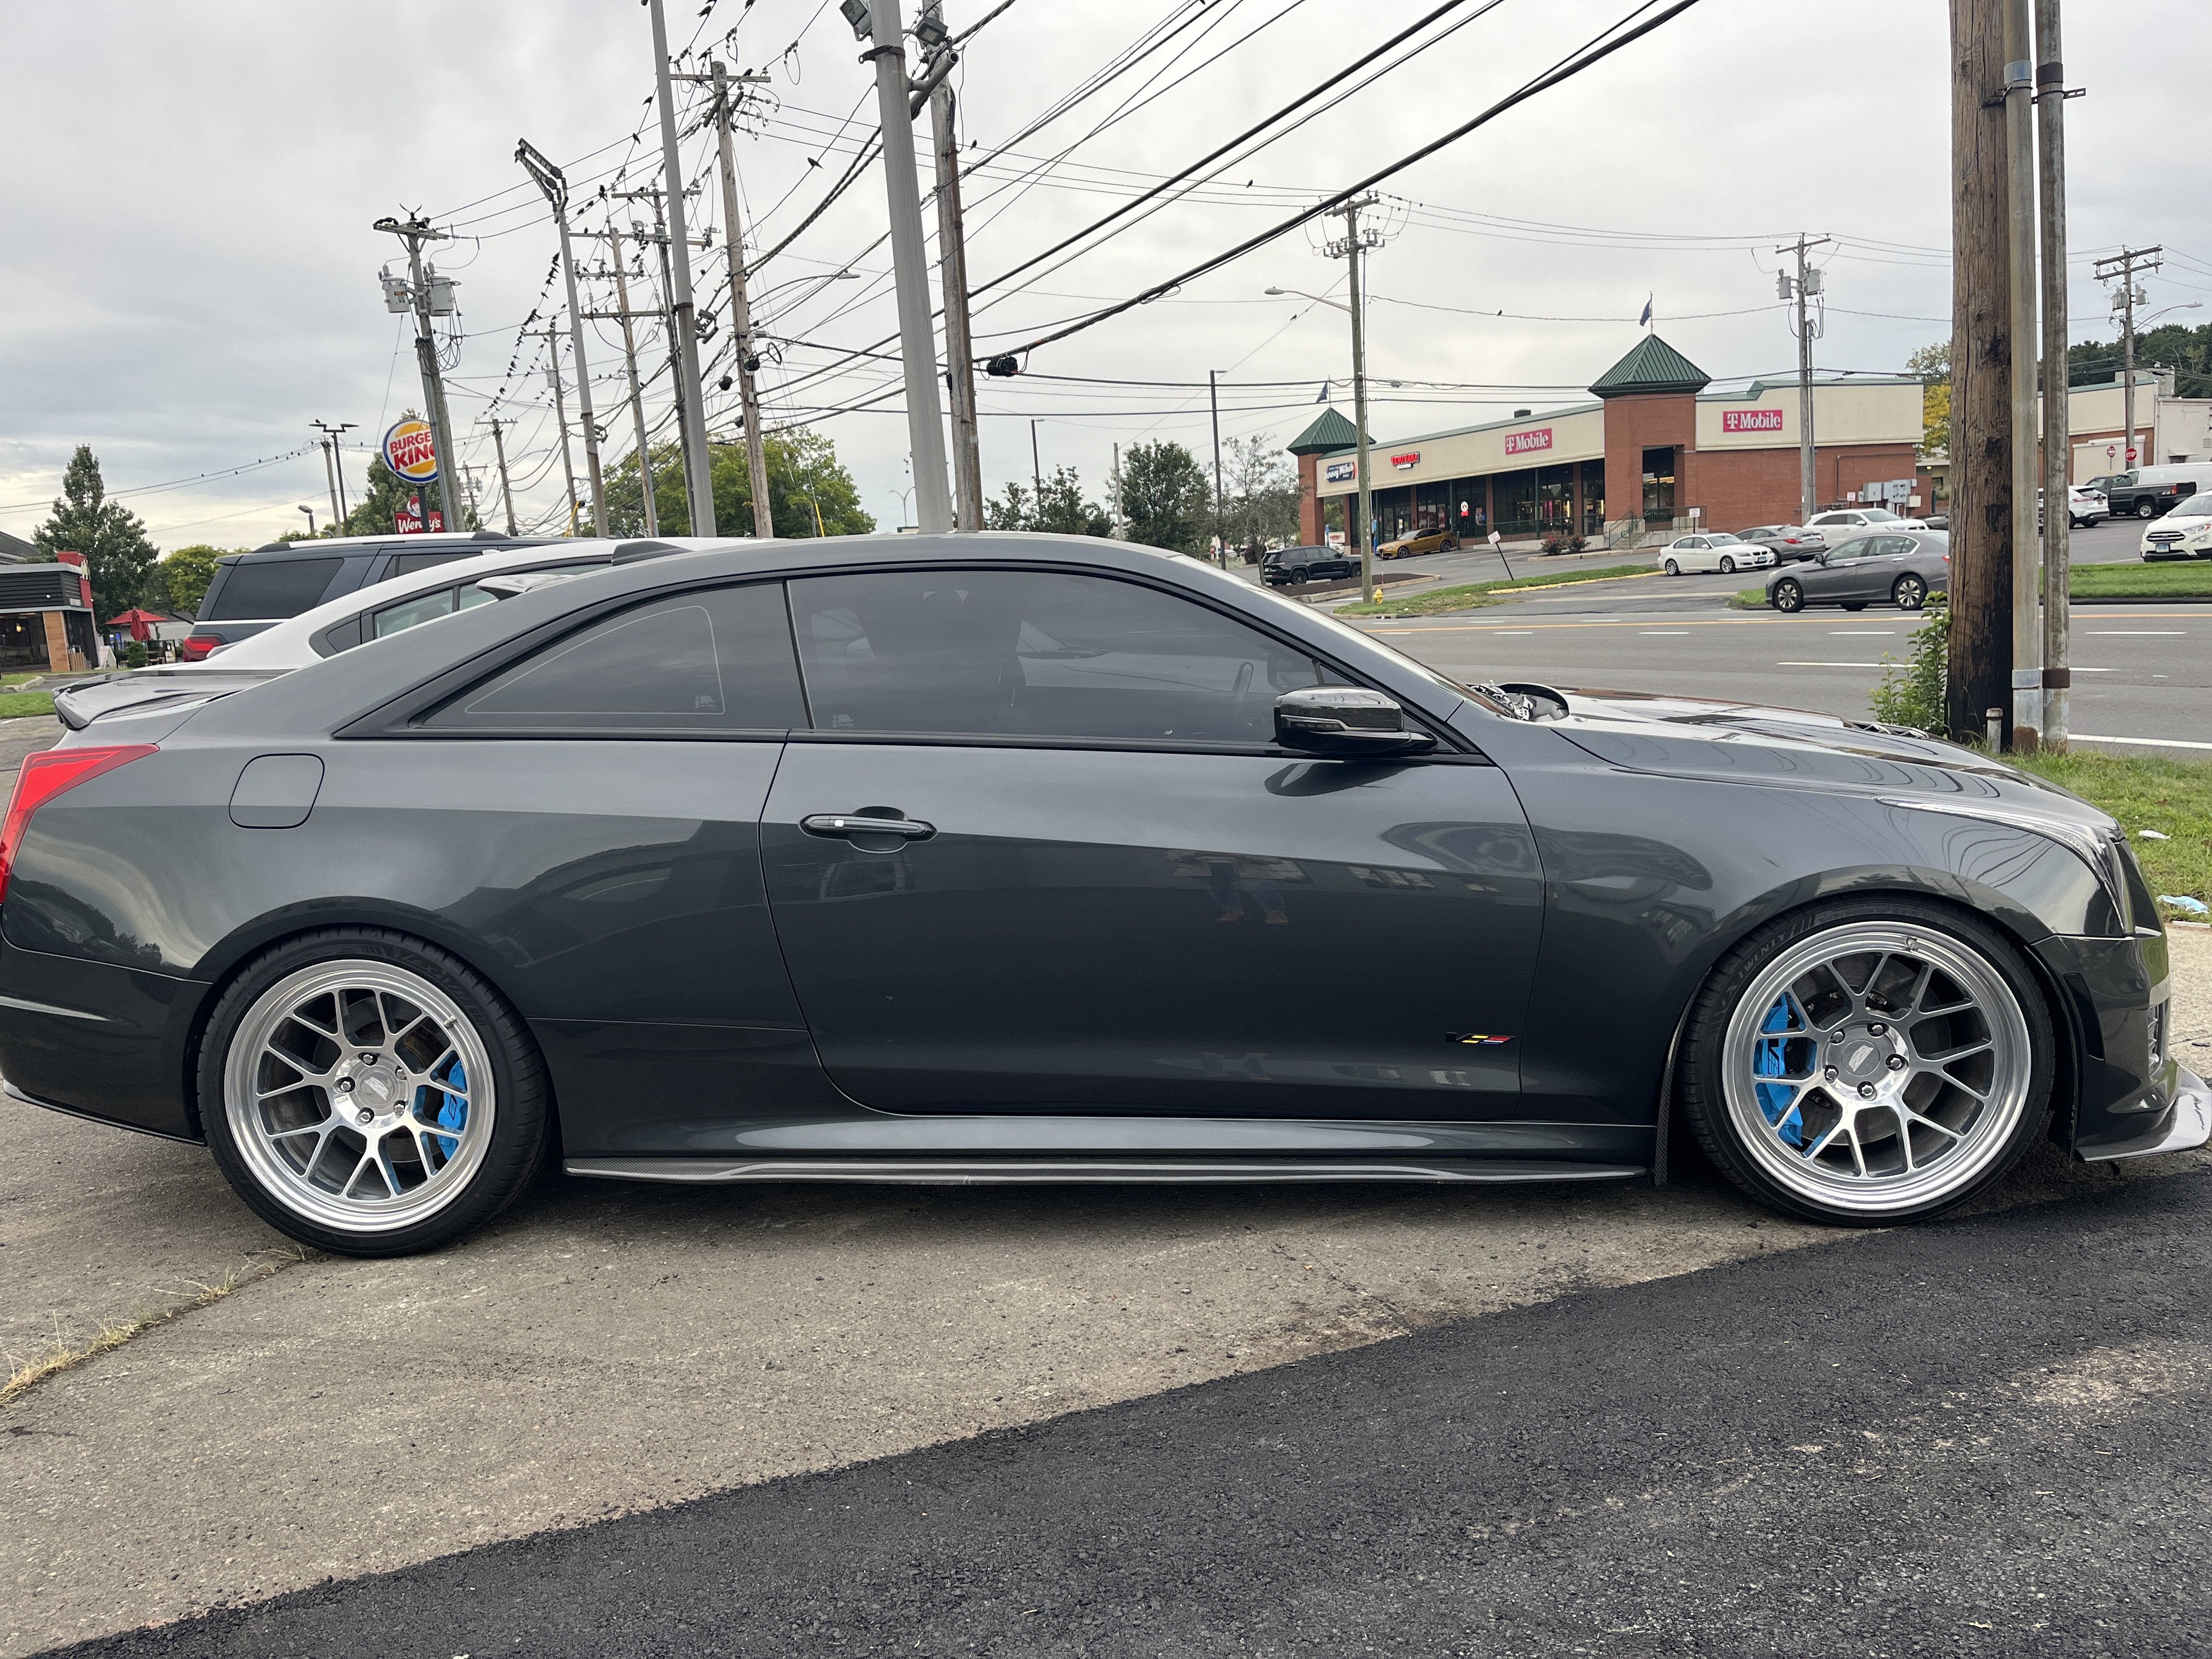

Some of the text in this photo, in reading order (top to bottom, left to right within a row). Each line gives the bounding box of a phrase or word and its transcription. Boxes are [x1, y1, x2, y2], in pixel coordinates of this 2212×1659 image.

[1740, 412, 1781, 429] Mobile
[390, 431, 431, 454] BURGE
[1516, 432, 1549, 451] Mobile
[398, 517, 441, 533] Weny's
